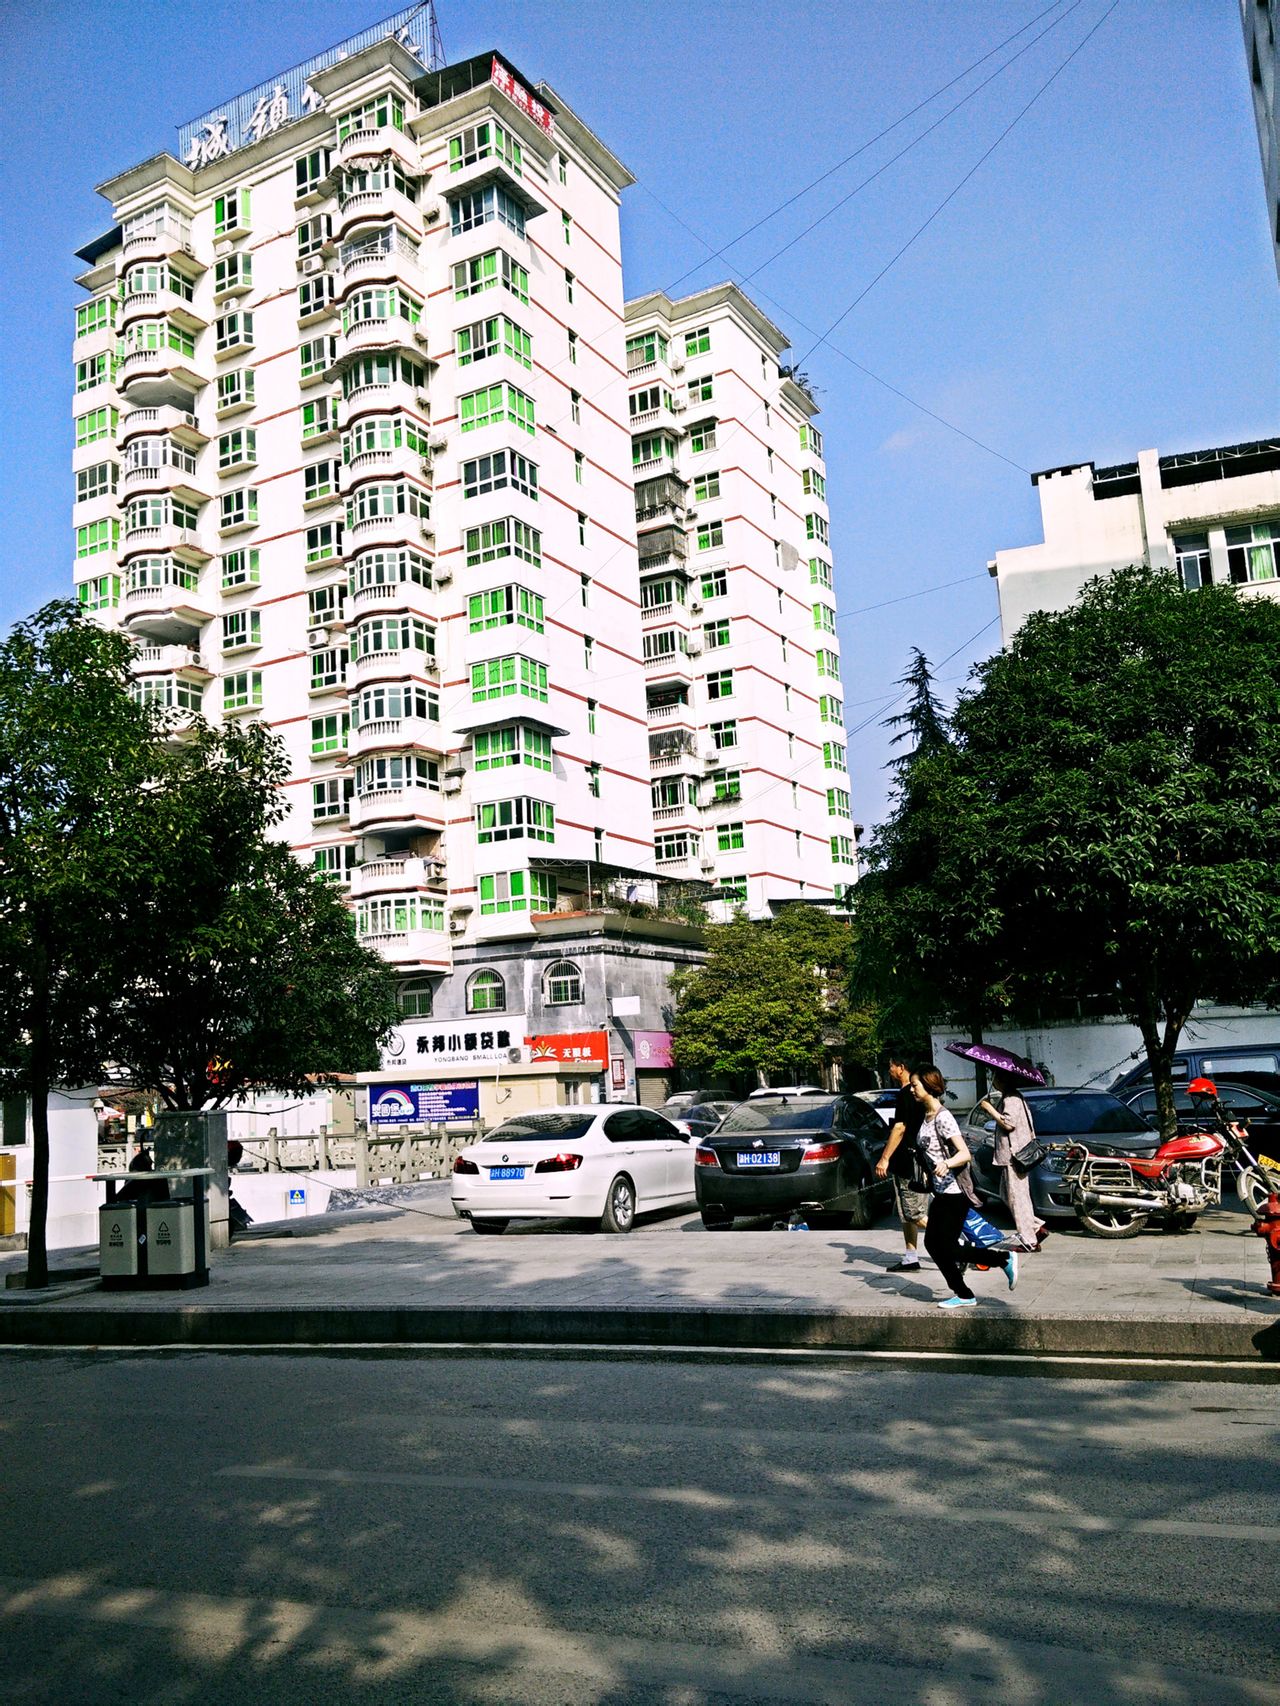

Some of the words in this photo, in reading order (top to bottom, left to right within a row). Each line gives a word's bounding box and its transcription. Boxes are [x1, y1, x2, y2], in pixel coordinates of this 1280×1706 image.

[416, 1030, 511, 1054] 永邦小额贷款
